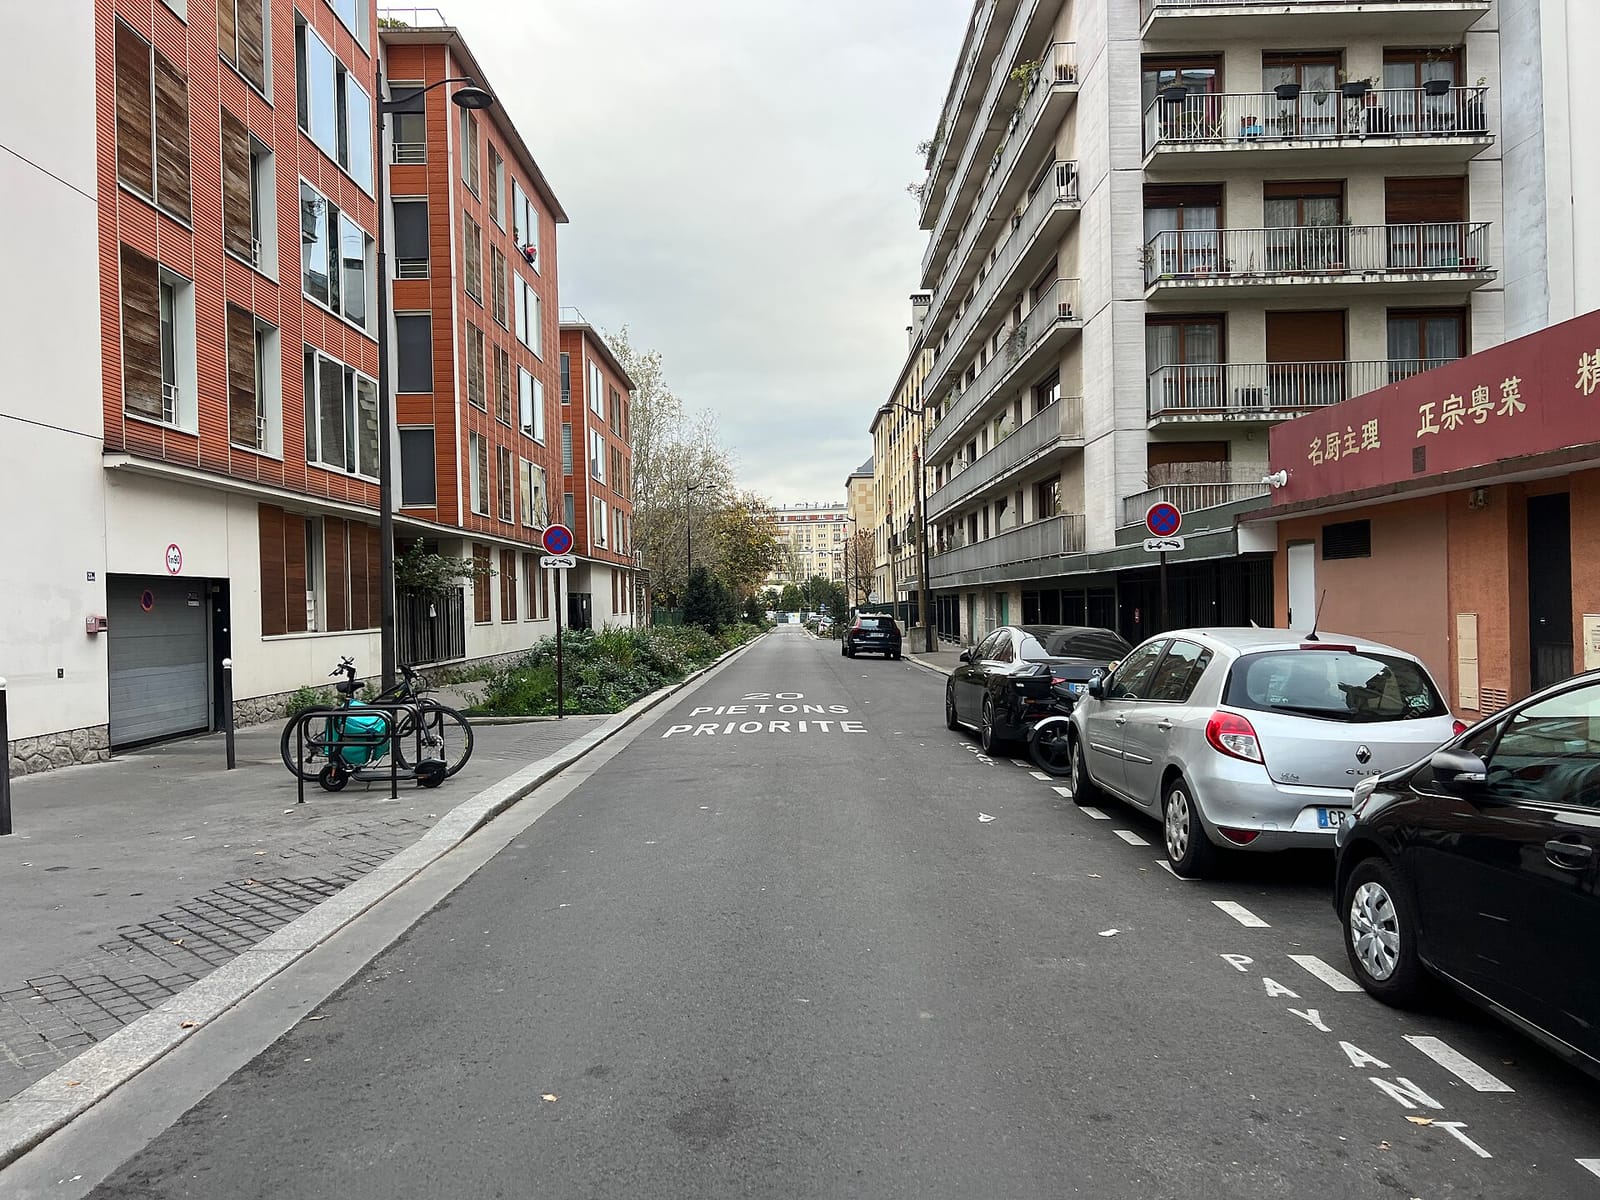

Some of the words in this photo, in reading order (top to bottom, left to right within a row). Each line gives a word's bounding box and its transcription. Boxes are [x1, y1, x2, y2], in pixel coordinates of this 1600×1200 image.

[1308, 418, 1381, 466] 名厨主理
[1417, 375, 1526, 439] 正宗粤菜
[741, 692, 804, 701] 20
[688, 704, 849, 717] PIETONS
[661, 720, 868, 738] PRIORITE
[1219, 953, 1493, 1159] PAYANT
